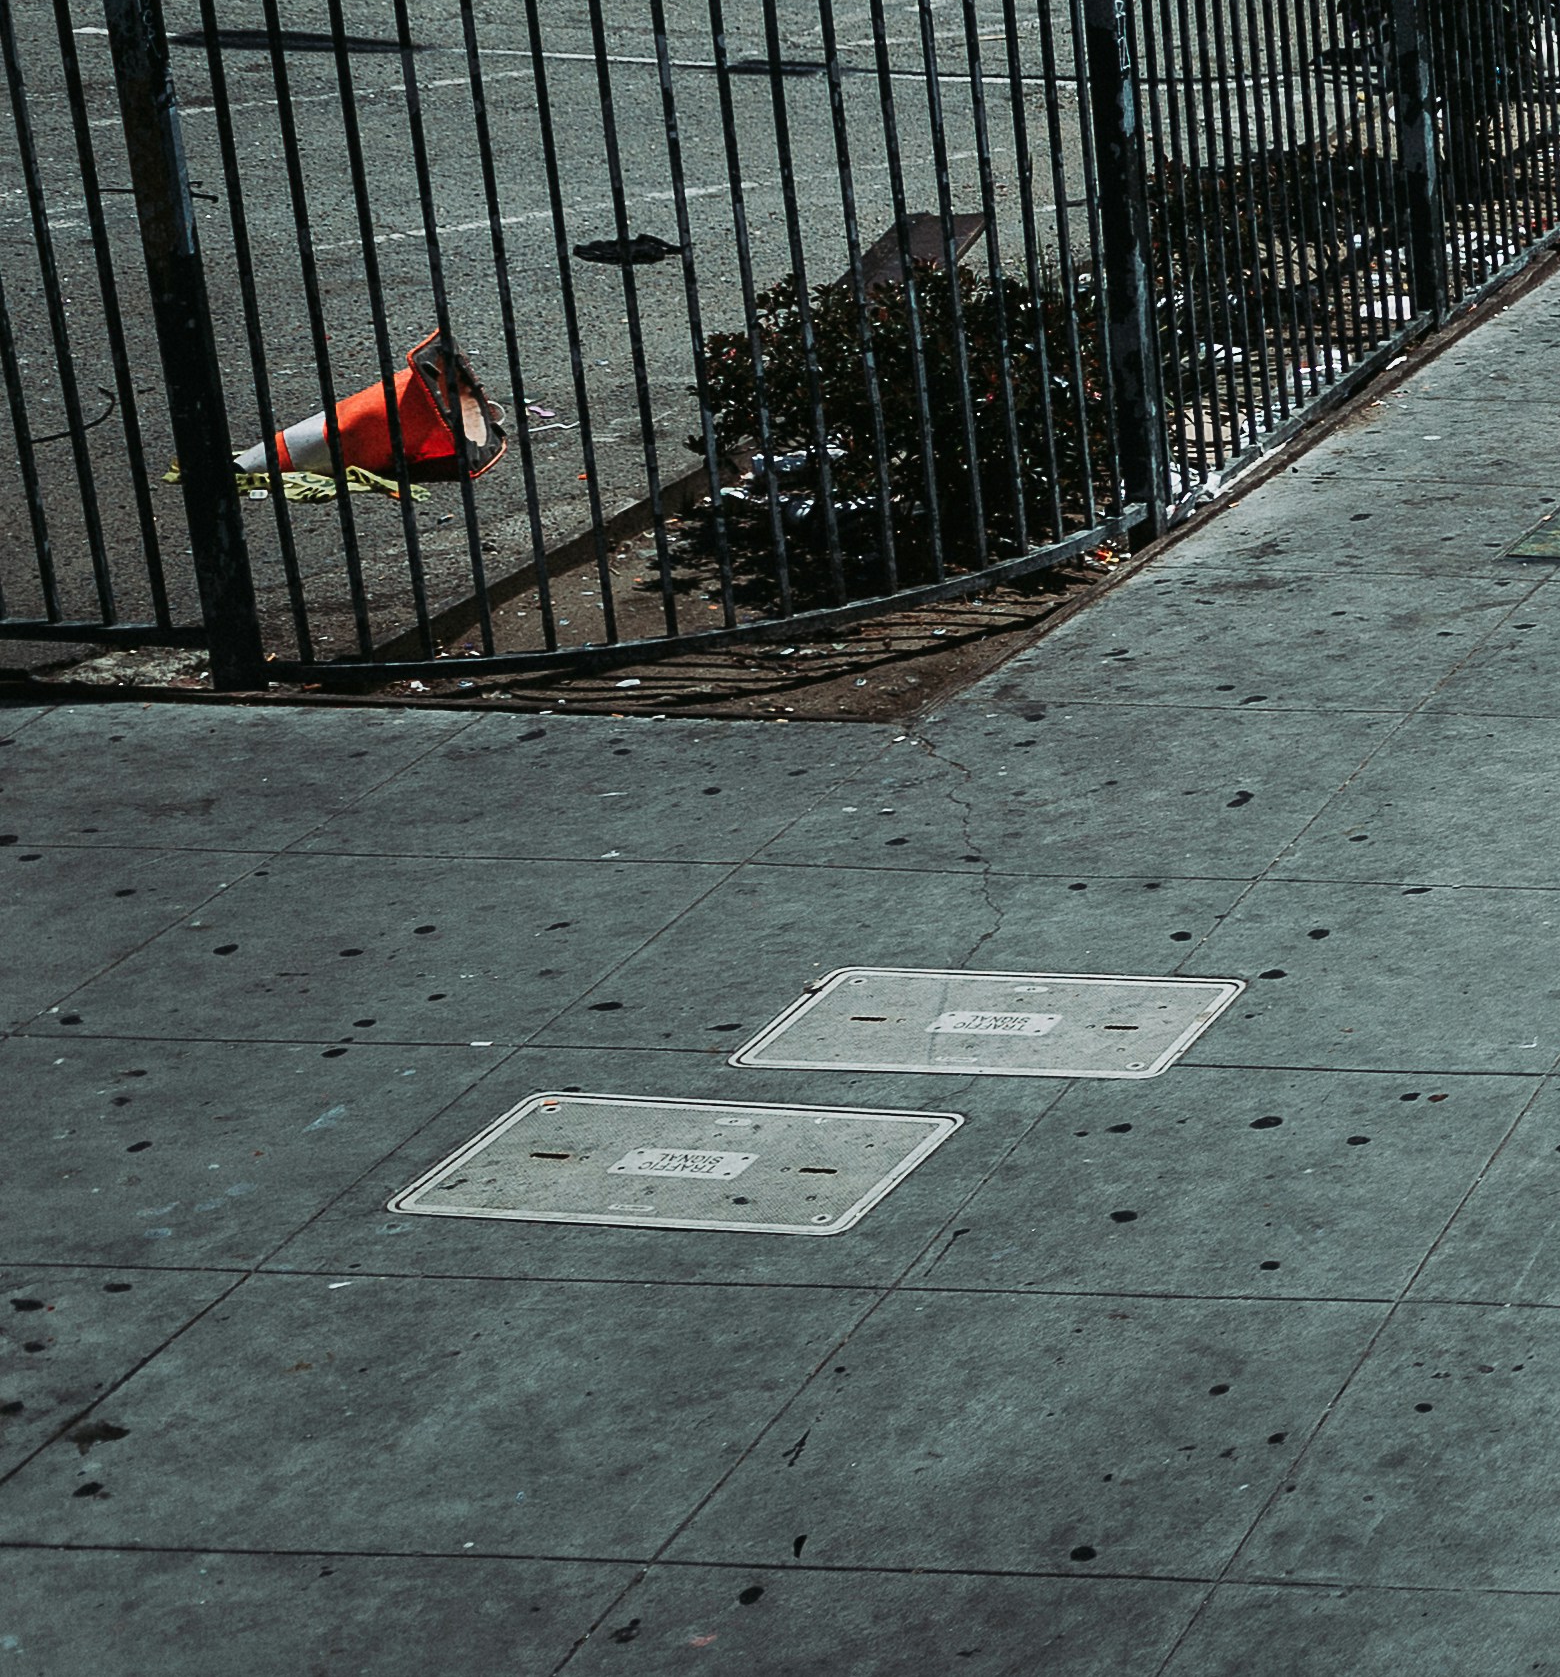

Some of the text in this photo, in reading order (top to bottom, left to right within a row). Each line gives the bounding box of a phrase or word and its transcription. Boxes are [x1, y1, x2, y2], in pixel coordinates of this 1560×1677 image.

[970, 1015, 1031, 1024] SIGNAL
[953, 1022, 1025, 1031] TRAFFIC
[659, 1153, 724, 1164] SIGNAL
[638, 1161, 716, 1174] TRAFFIC
